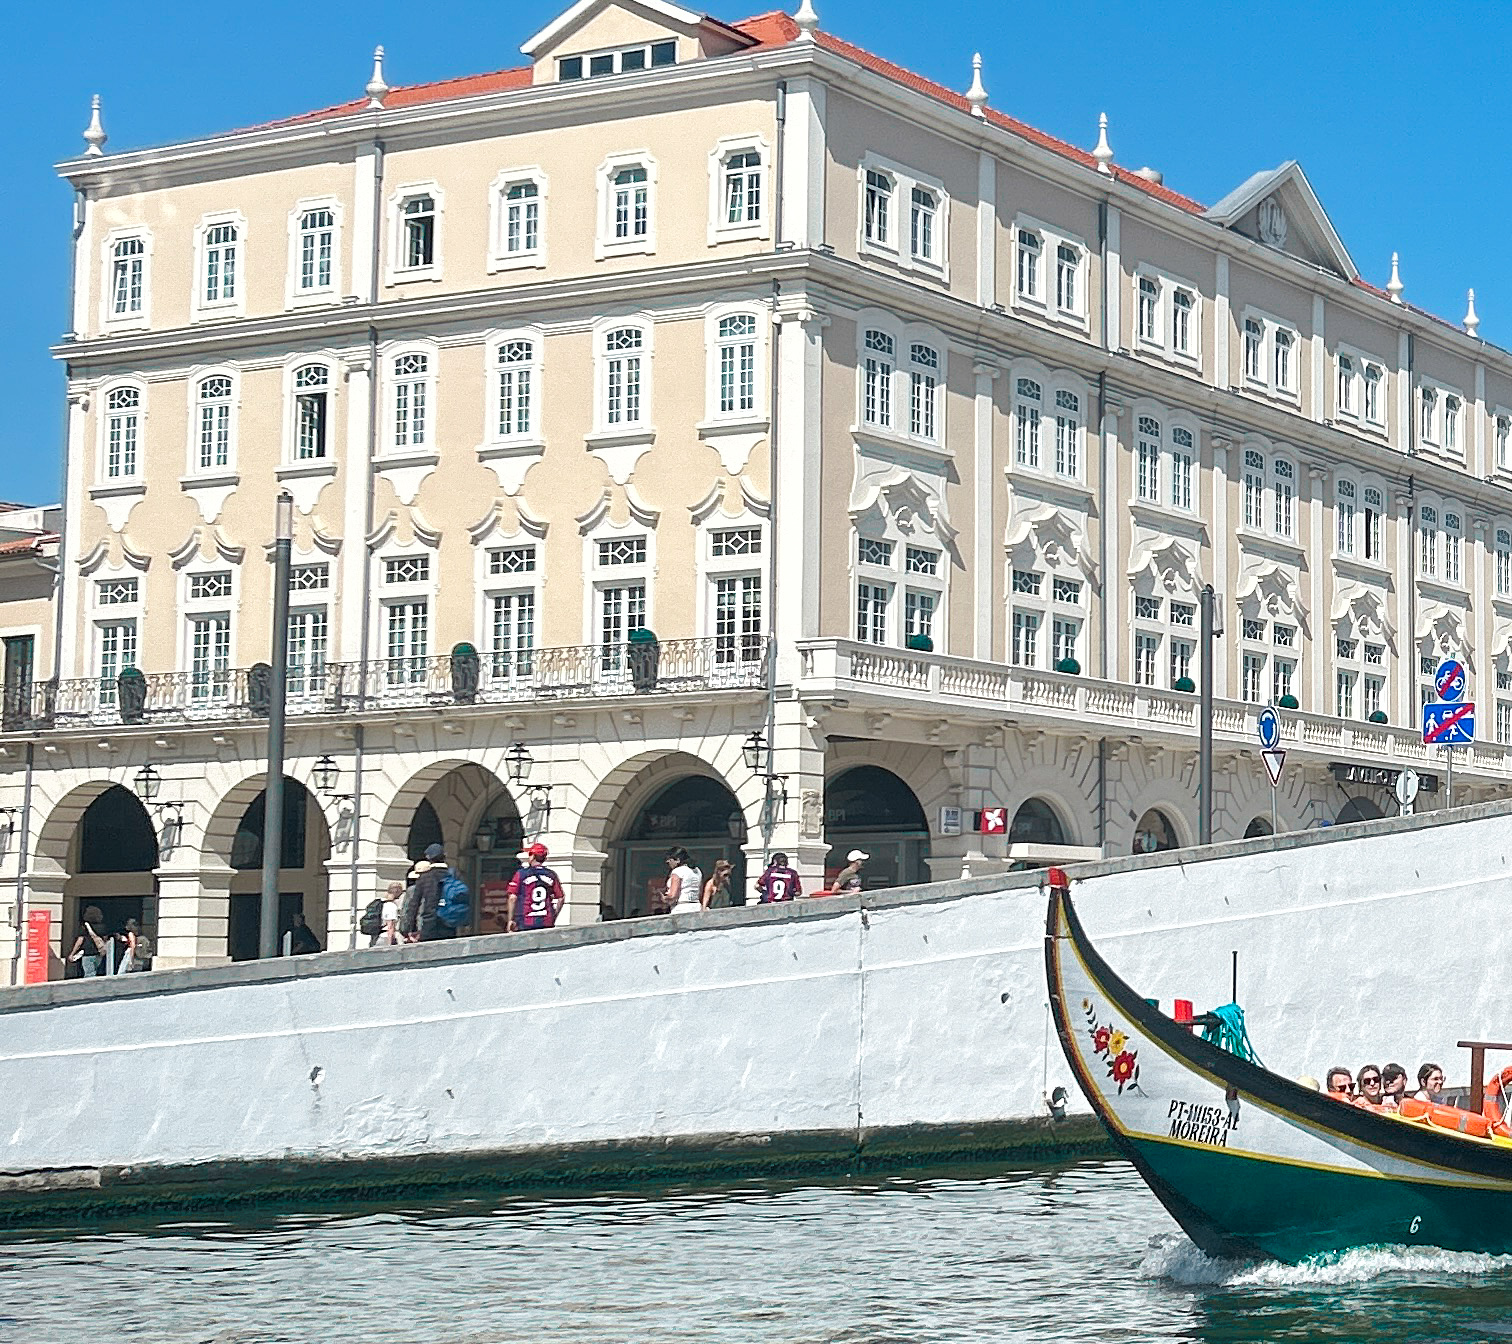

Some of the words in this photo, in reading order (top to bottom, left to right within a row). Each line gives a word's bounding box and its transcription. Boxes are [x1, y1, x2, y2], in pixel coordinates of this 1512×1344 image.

[532, 886, 547, 911] 9
[773, 880, 785, 900] 9
[1168, 1119, 1228, 1148] MOREIRA
[1409, 1215, 1422, 1234] 6
